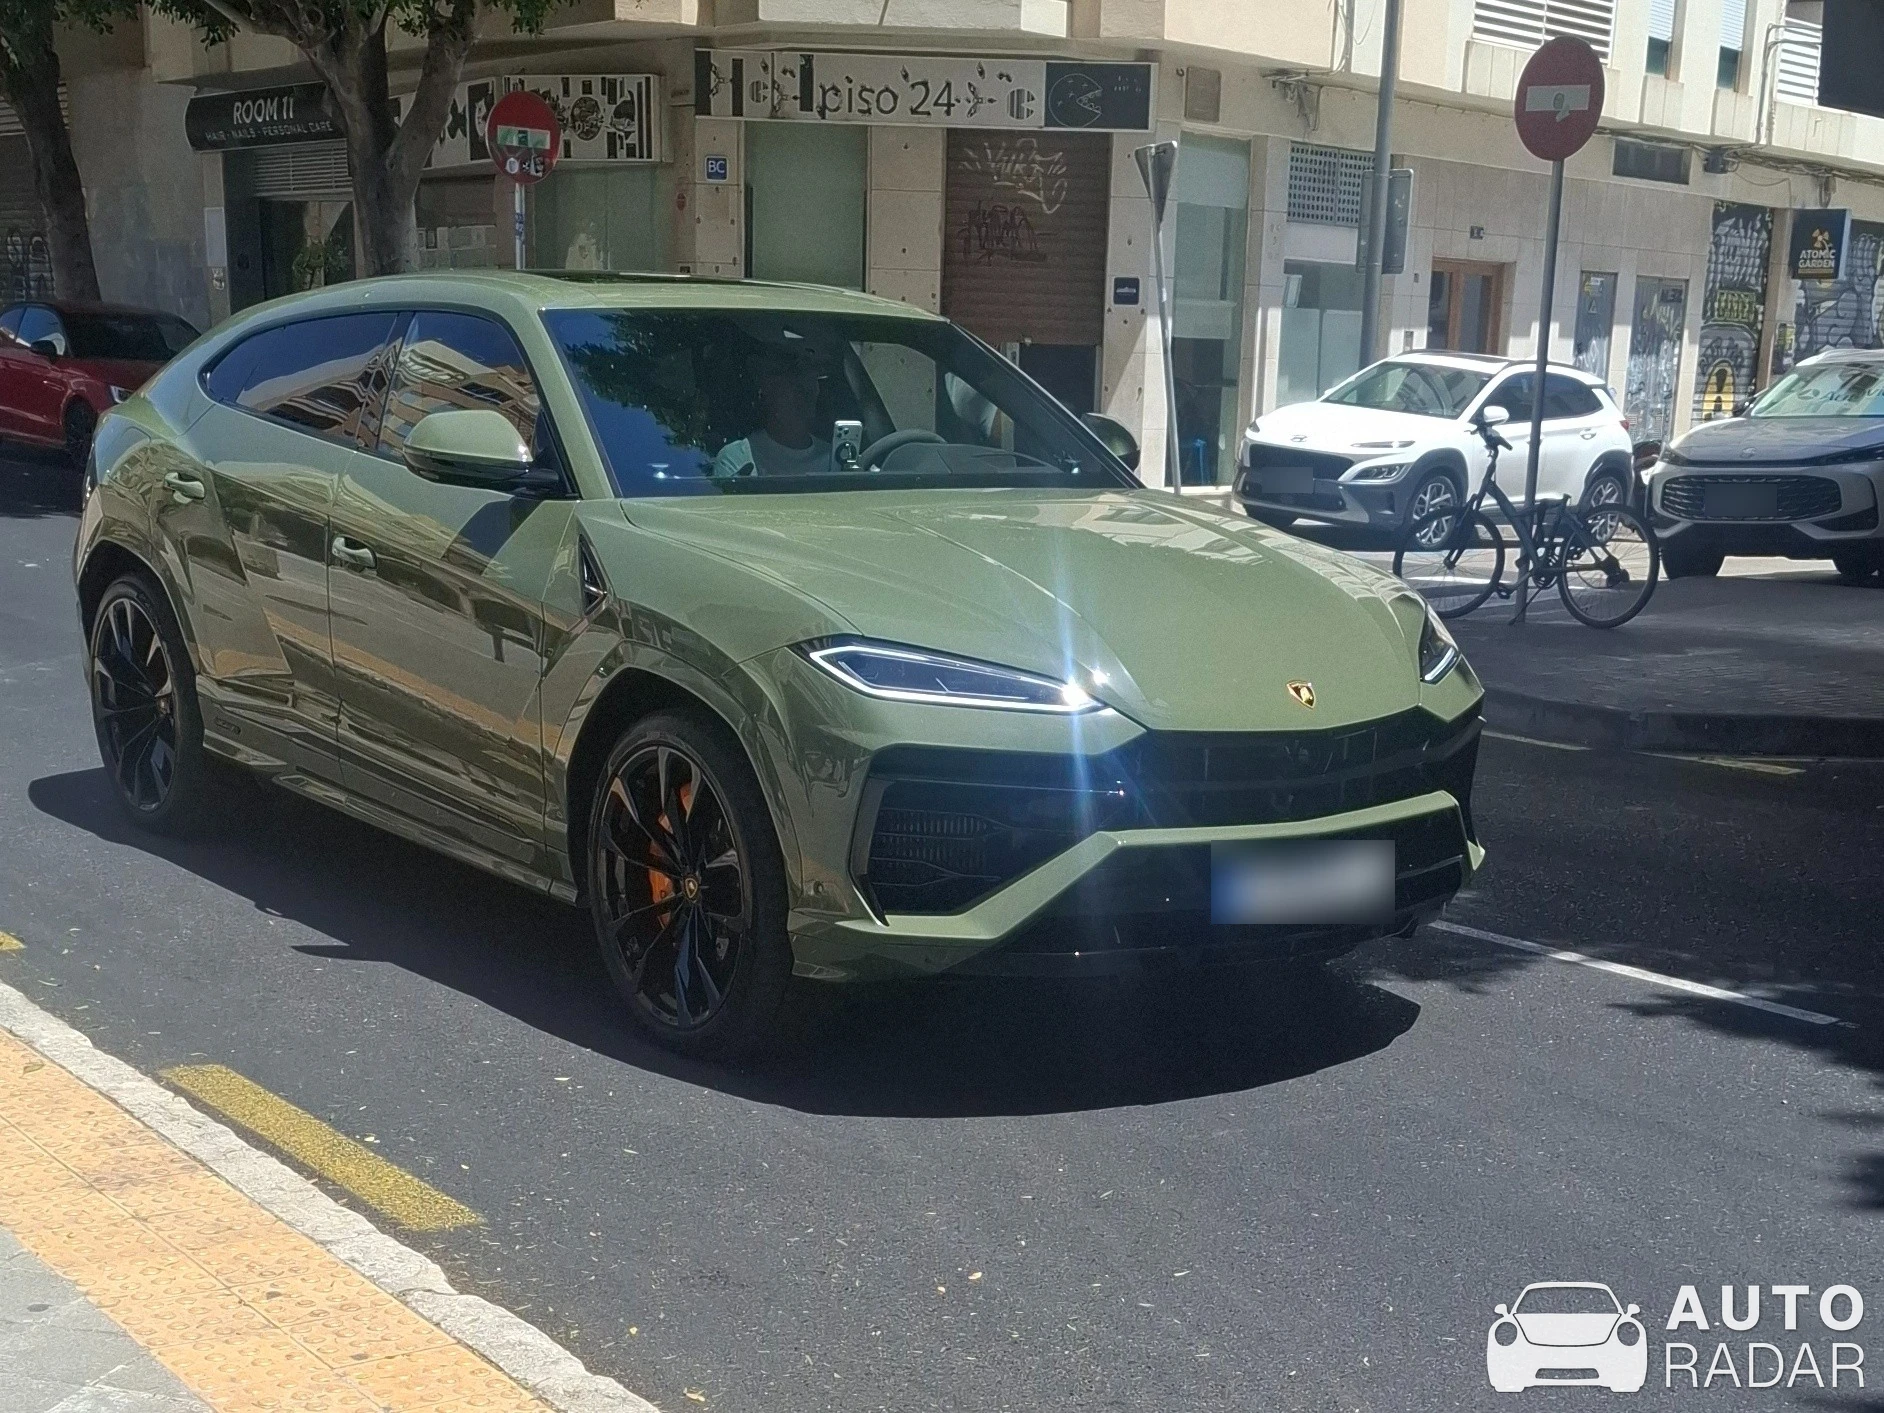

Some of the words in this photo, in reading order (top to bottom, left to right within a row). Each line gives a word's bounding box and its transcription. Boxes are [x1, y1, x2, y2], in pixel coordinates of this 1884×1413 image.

[816, 76, 899, 120] piso
[909, 80, 954, 117] 24
[233, 96, 278, 124] ROOM
[231, 127, 256, 138] NAILS
[262, 123, 308, 136] PERSONAL
[308, 120, 334, 132] CARE
[708, 160, 726, 173] BC
[1800, 249, 1836, 259] ATOMIC
[1798, 259, 1835, 268] GARDEN
